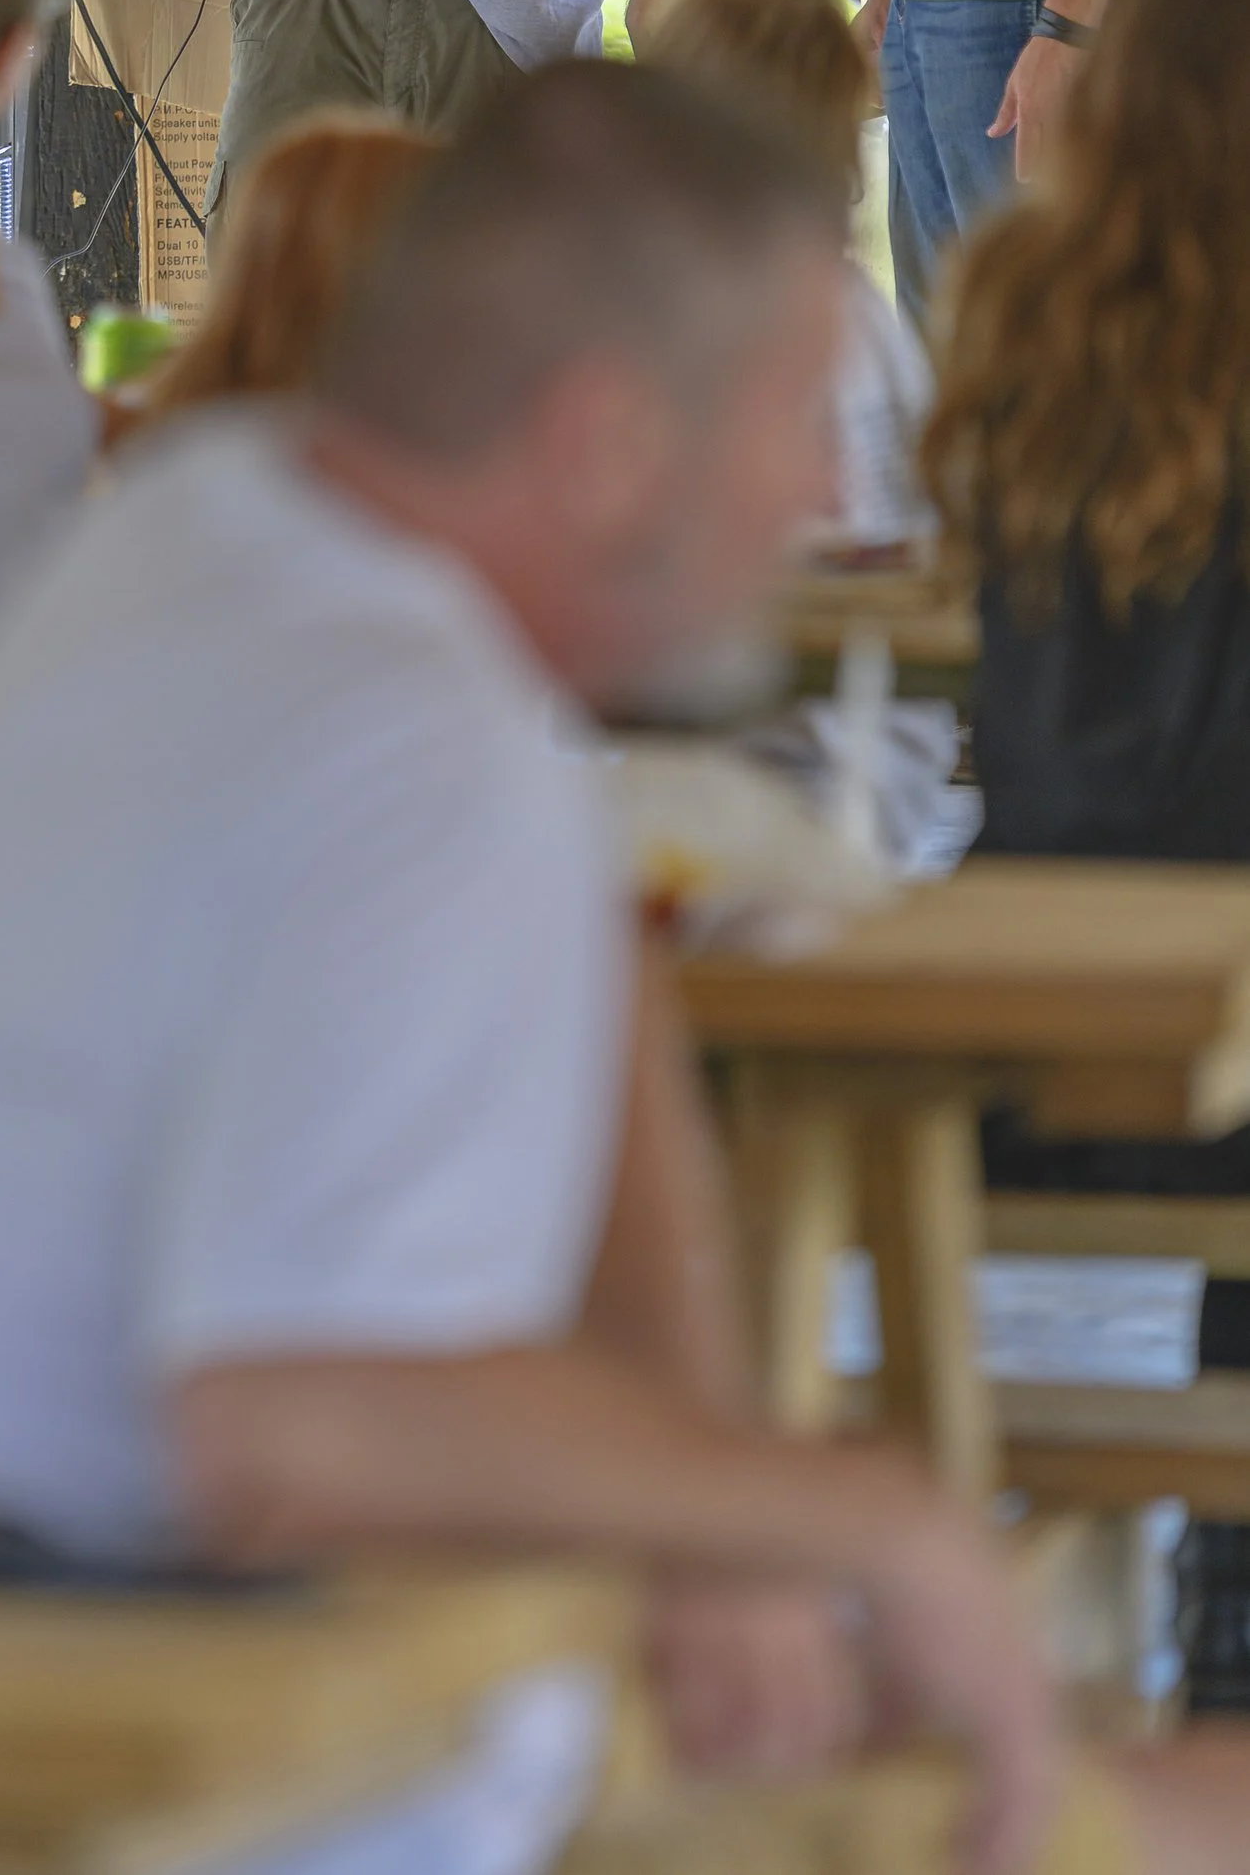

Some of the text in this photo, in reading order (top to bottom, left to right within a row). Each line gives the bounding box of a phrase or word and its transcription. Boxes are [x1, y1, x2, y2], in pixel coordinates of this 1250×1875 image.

[153, 118, 196, 130] Speaker
[153, 132, 189, 143] Supply
[154, 159, 215, 170] Otput Pow
[157, 240, 182, 251] Dual
[186, 240, 199, 250] 10
